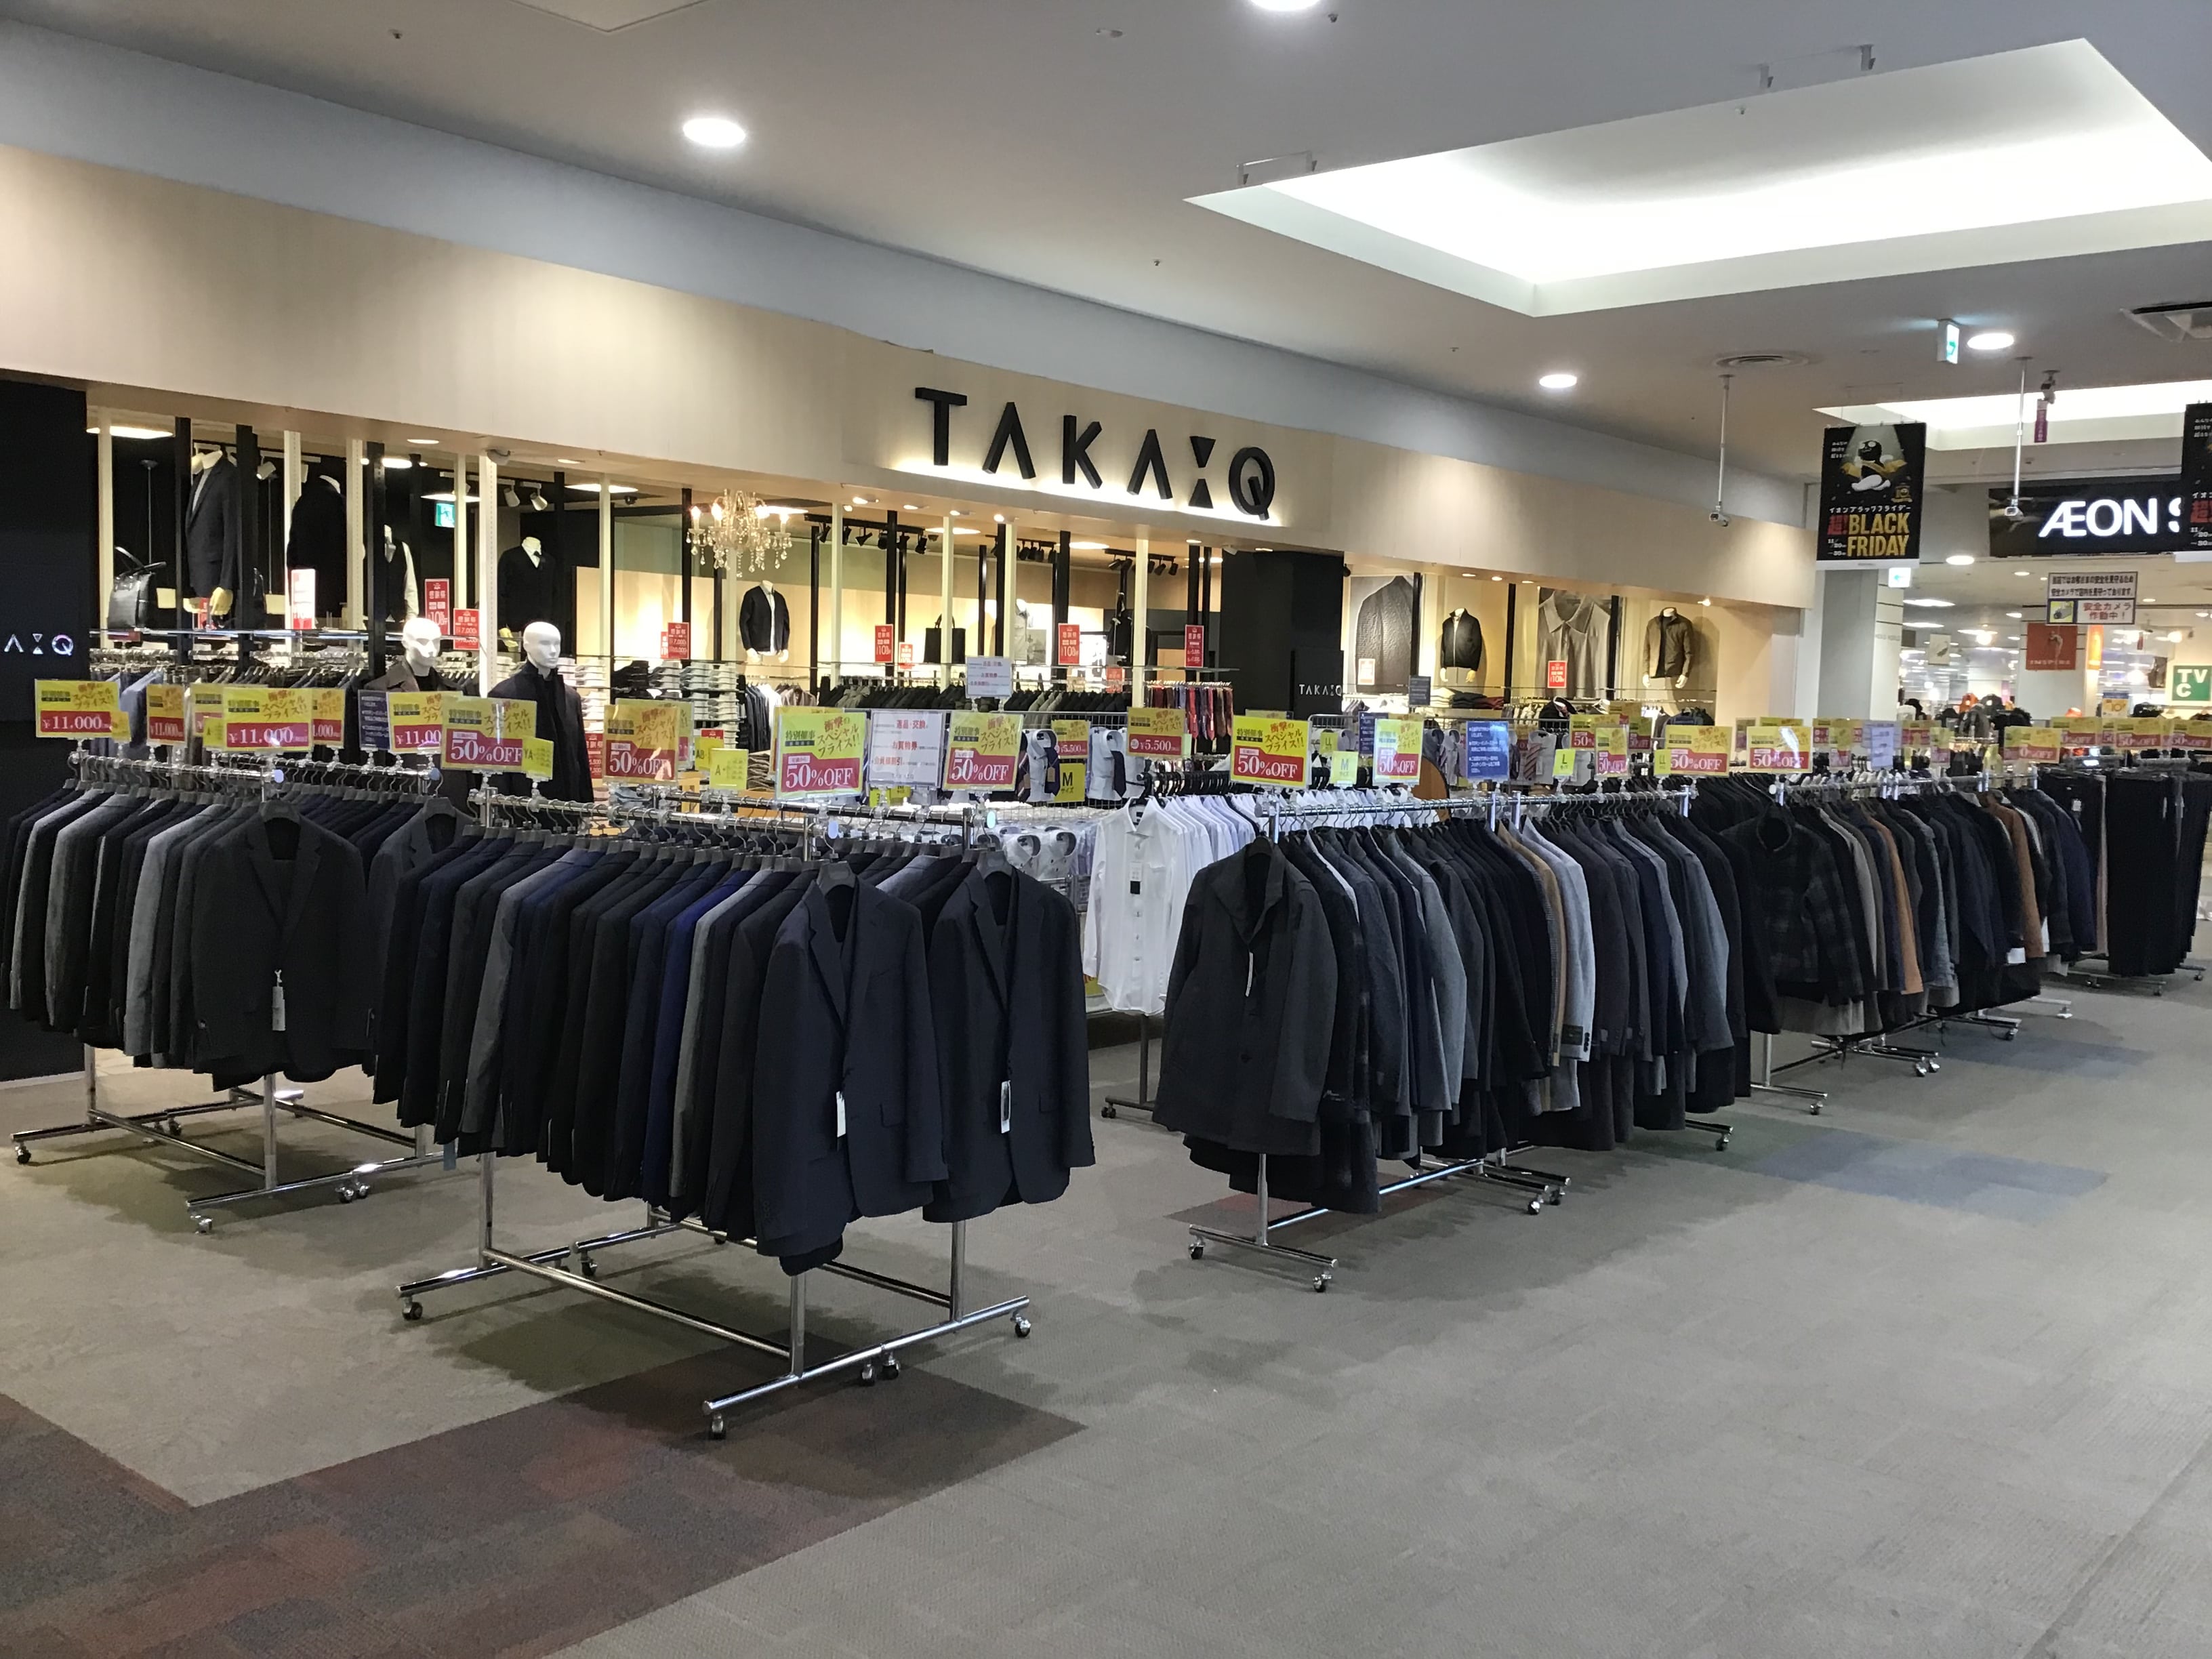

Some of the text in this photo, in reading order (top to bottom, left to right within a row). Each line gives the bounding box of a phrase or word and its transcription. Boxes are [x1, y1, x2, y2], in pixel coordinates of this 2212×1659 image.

[1848, 512, 1910, 535] BLACK
[1847, 535, 1910, 556] FRIDAY
[2083, 602, 2131, 611] 安全カメラ
[951, 758, 1009, 781] 50%OFF
[1238, 755, 1298, 778] 50%OFF
[1671, 754, 1722, 770] 50%OFF
[786, 764, 853, 788] 50%OFF
[1063, 772, 1073, 786] M
